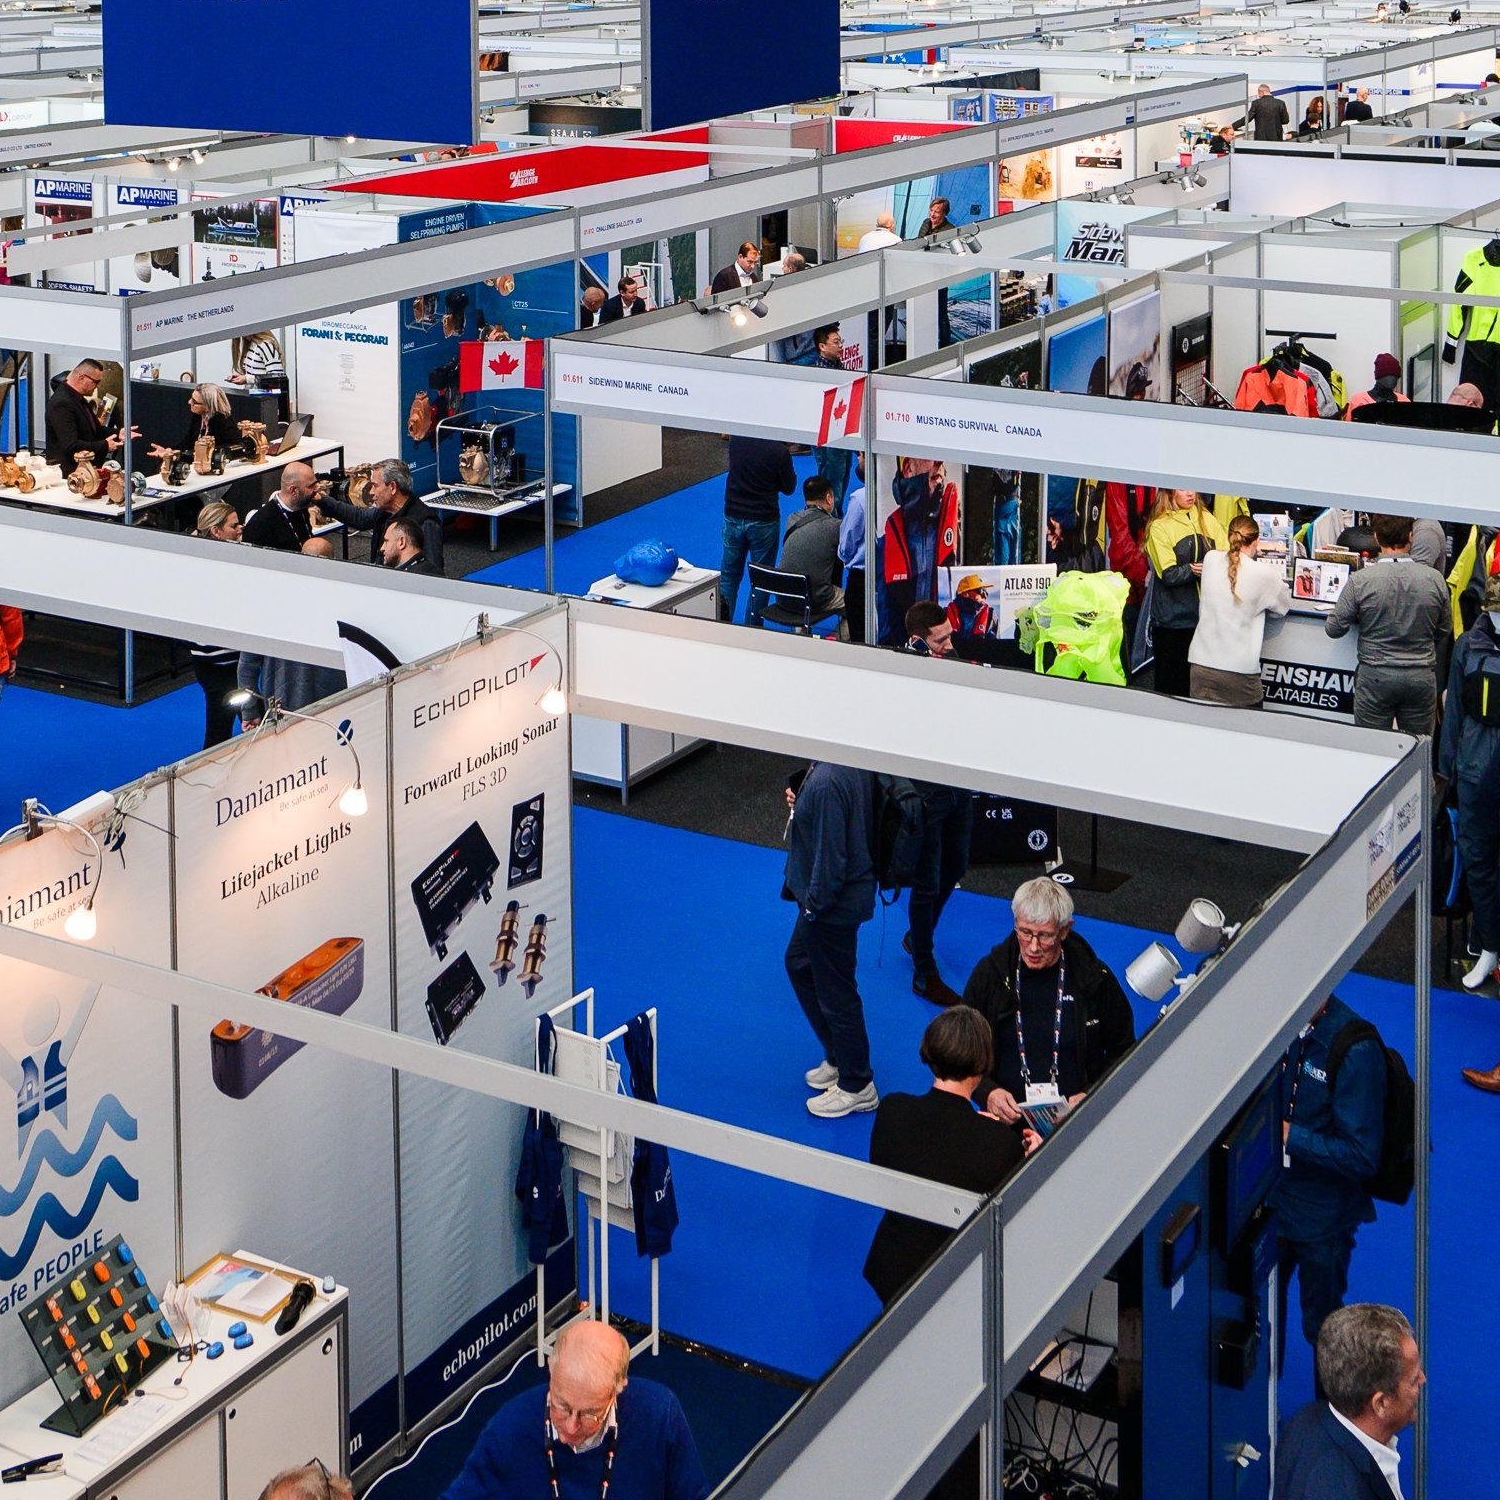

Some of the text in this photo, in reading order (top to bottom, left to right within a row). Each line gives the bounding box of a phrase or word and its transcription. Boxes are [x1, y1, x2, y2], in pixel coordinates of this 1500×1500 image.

[410, 225, 445, 240] SELFPRIMING
[426, 213, 464, 227] ENGINE DRIVEN
[1073, 222, 1124, 242] Sidew
[1063, 239, 1124, 263] Mar
[136, 322, 152, 332] 01.511
[164, 316, 184, 326] MARINE
[198, 305, 234, 319] NETHERLANDS
[322, 321, 367, 330] IDROMECCANICA
[302, 328, 388, 345] FORANI & PECORARI
[563, 374, 688, 396] 01.611 SIDEWIND MARINE CANADA
[886, 412, 1042, 438] 01.710 MUSTANG SURVIVAL CANADA
[1005, 578, 1032, 590] ATLAS
[1261, 662, 1356, 693] ENSHA
[1261, 685, 1338, 708] LATABLES
[405, 717, 559, 804] Forward Looking Sonar
[216, 755, 328, 827] Daniamant
[463, 766, 507, 801] FLS 3D
[222, 821, 351, 900] Lifejacket Lights
[257, 867, 319, 909] Alkaline
[34, 1229, 104, 1290] PEOPLE
